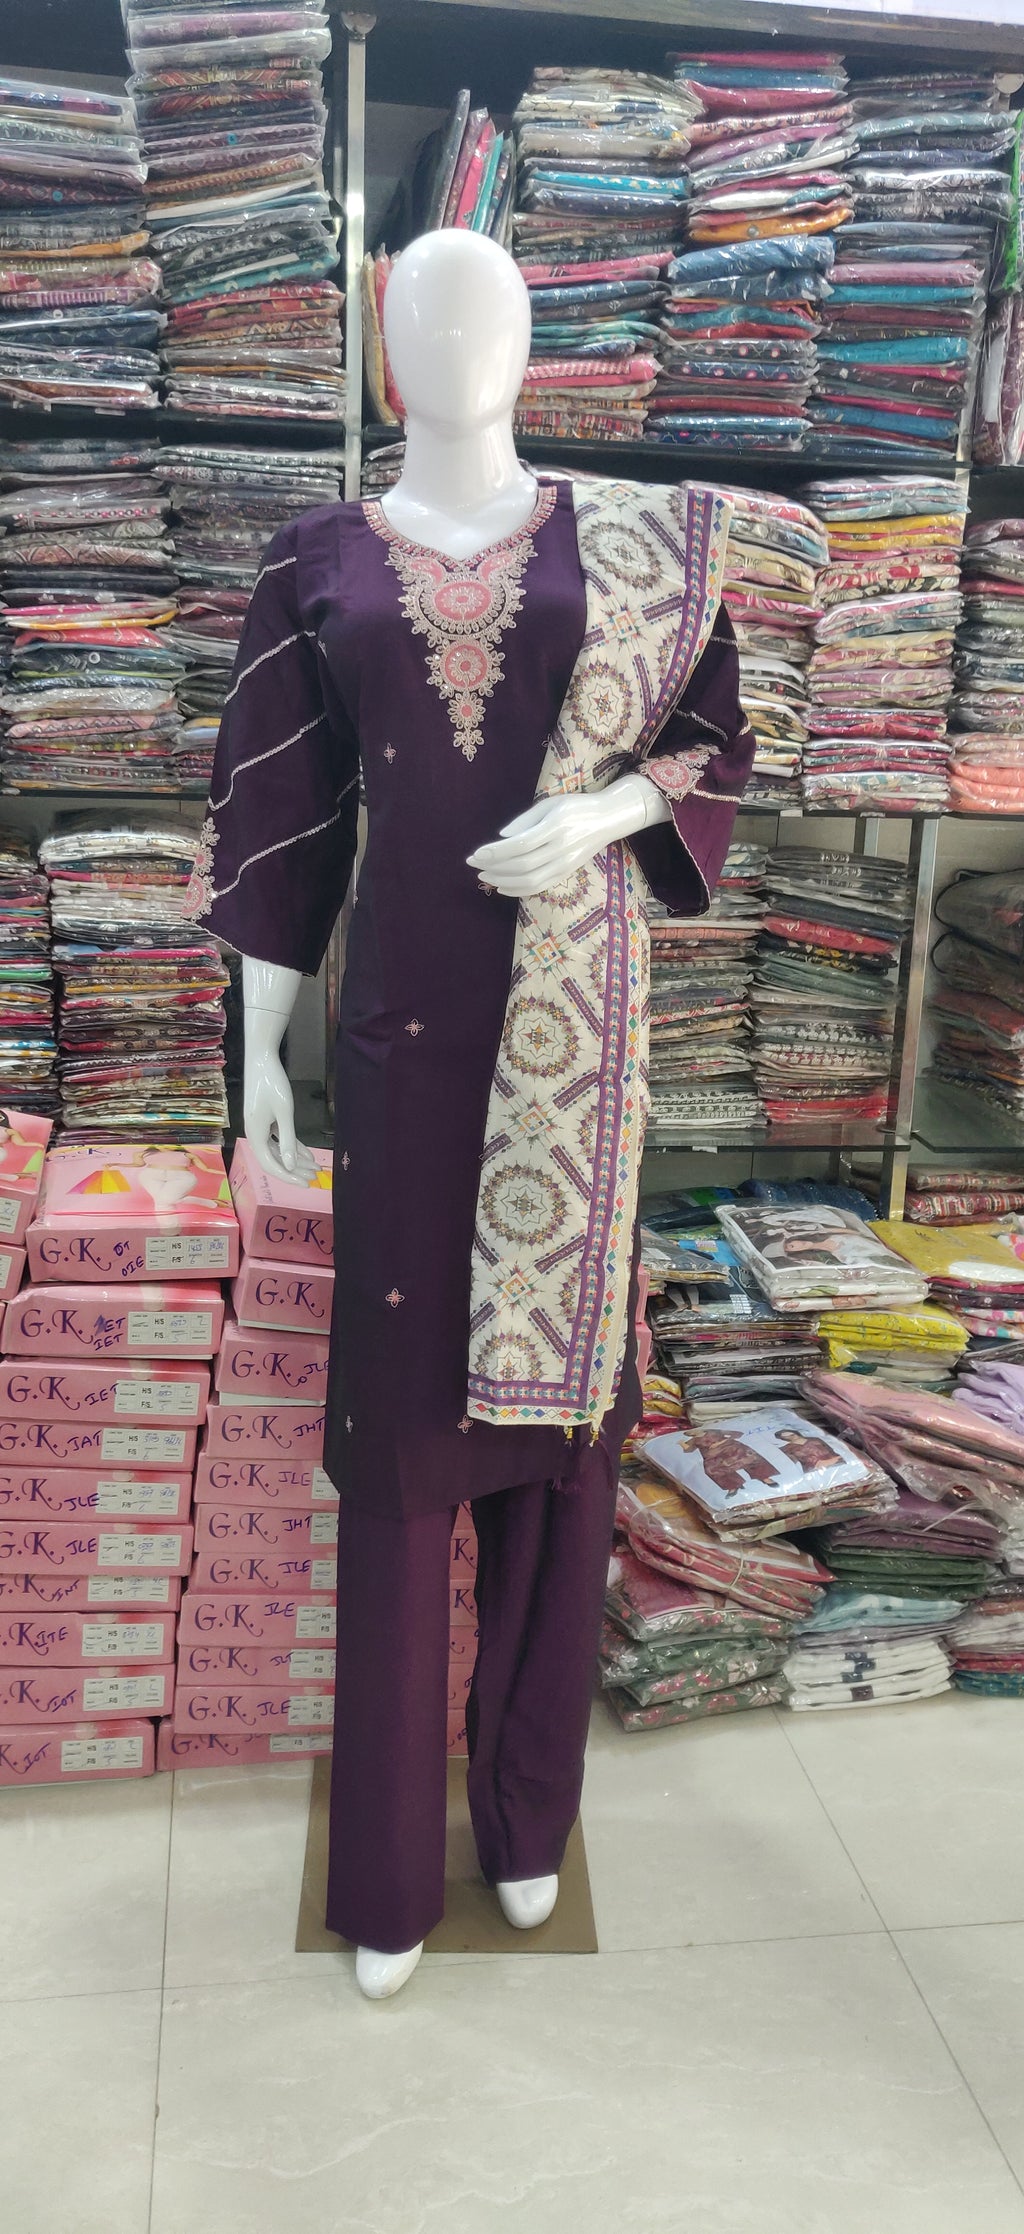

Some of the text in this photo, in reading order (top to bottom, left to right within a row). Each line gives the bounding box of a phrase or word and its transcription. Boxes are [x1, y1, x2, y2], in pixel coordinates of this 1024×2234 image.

[265, 1214, 334, 1255] G.K.
[39, 1237, 112, 1272] G.K.
[255, 1277, 325, 1318] G.K.
[20, 1308, 94, 1345] G.K.
[231, 1349, 300, 1388] G.K.
[7, 1375, 81, 1411] G.K.
[221, 1414, 293, 1449] G.K.
[209, 1461, 279, 1498] G.K.
[64, 1493, 100, 1511] JLE
[208, 1512, 279, 1544] G.K.
[65, 1538, 97, 1555] JLE
[210, 1558, 279, 1589] G.K.
[194, 1603, 264, 1637] G.K.
[189, 1648, 258, 1677] G.K.
[188, 1695, 257, 1726] G.K.
